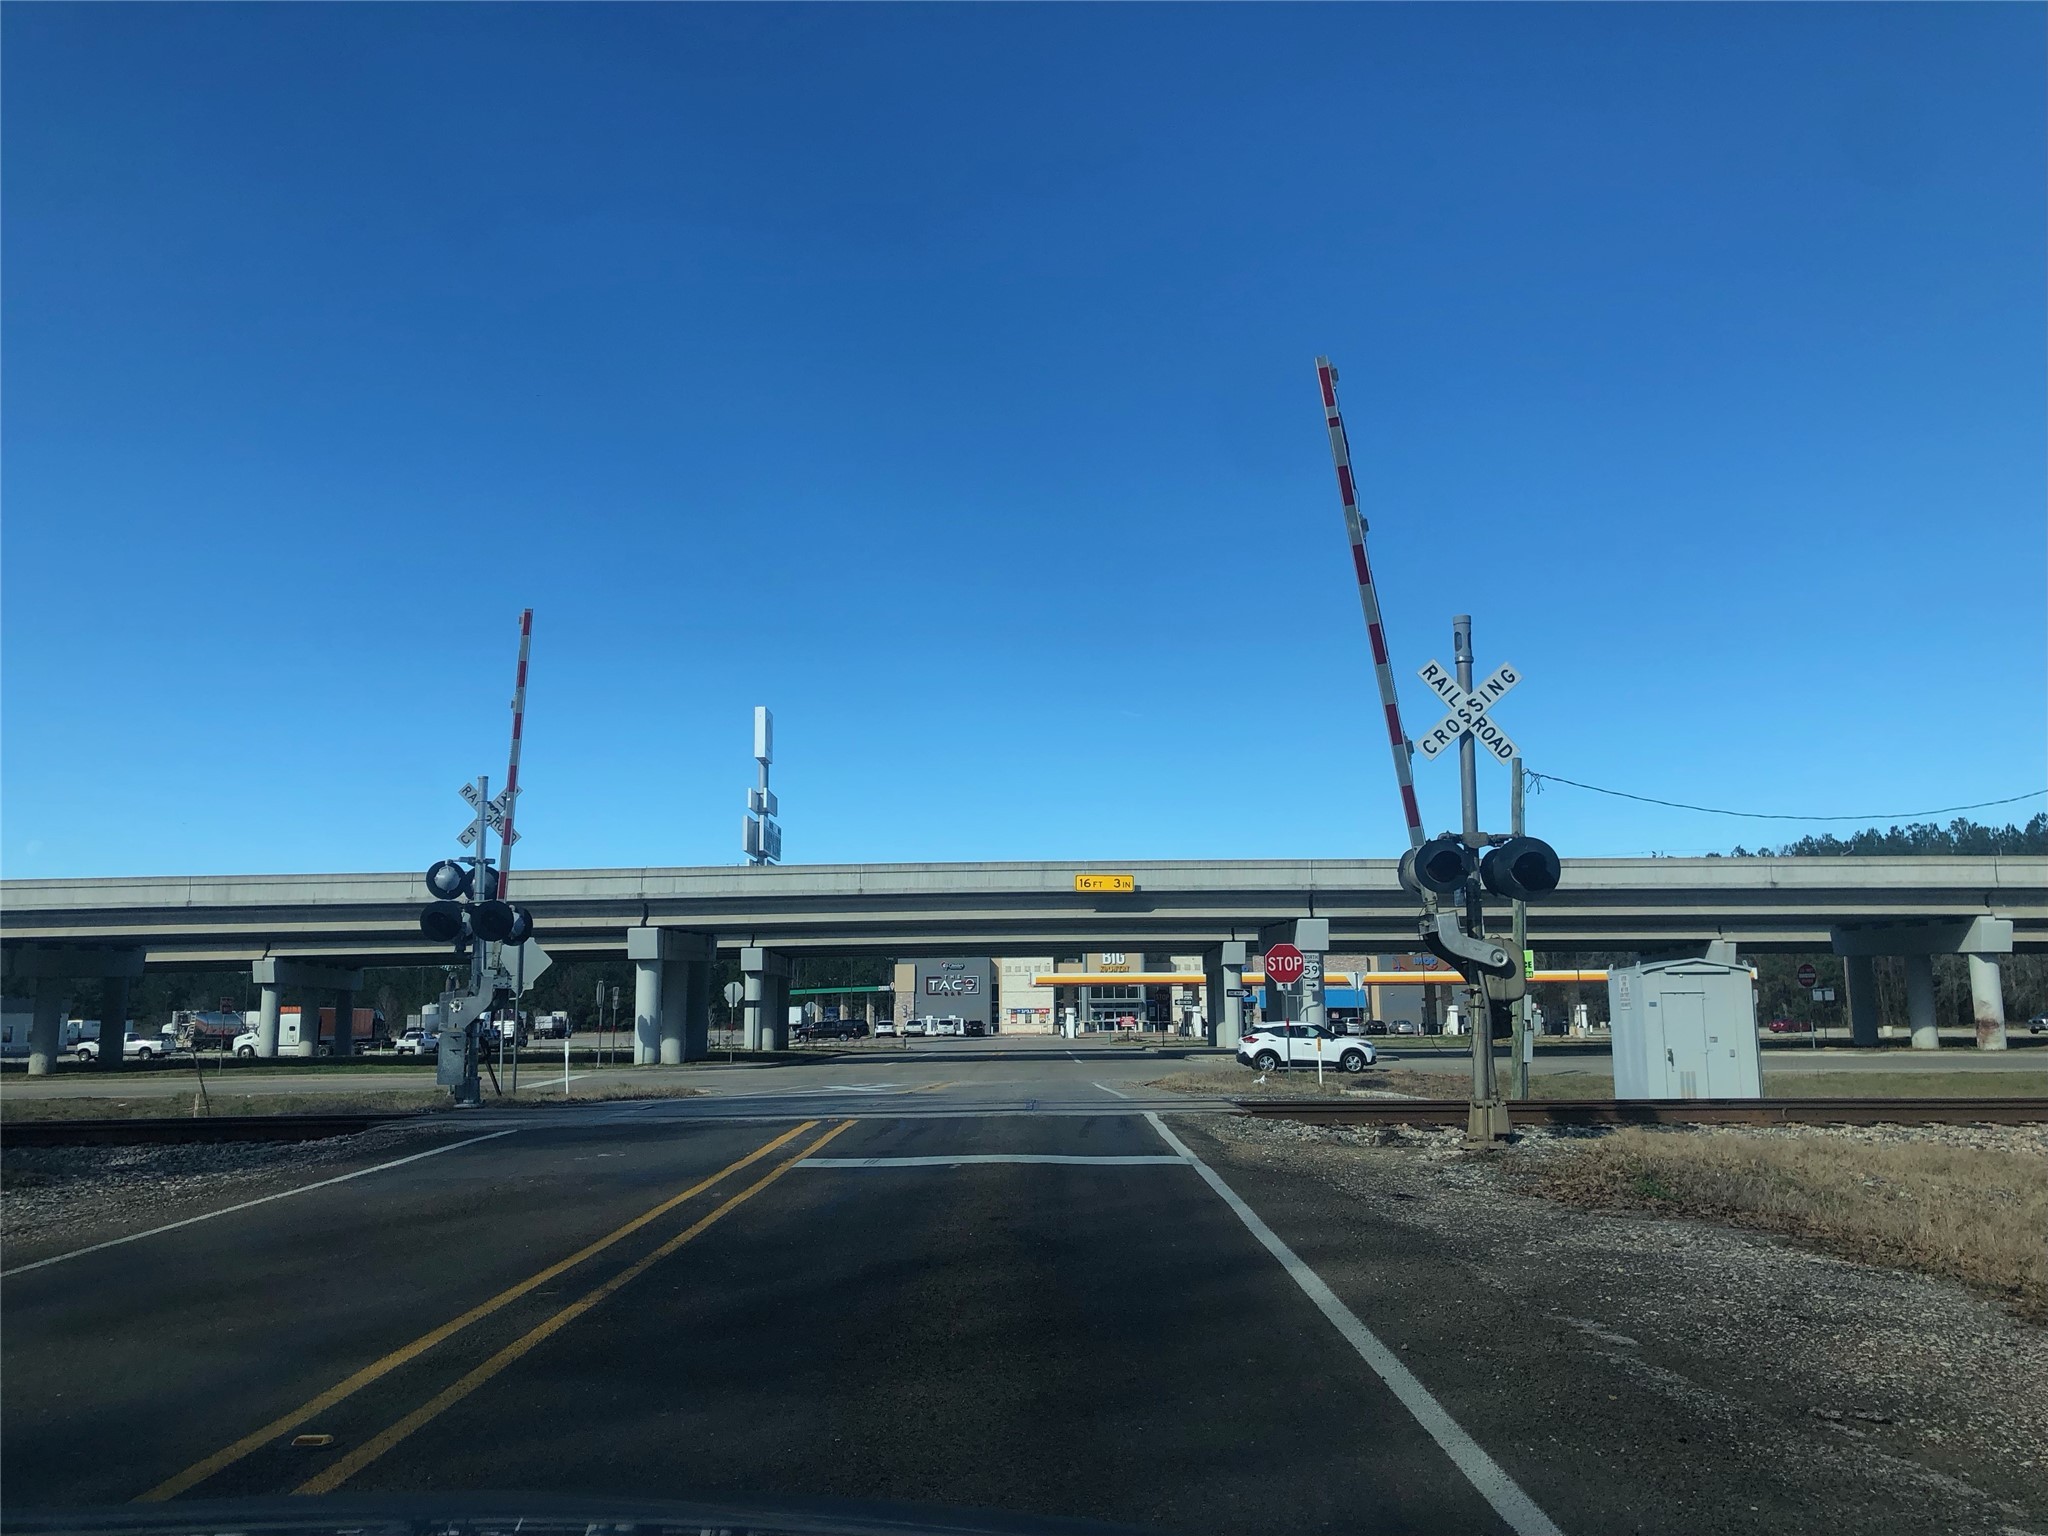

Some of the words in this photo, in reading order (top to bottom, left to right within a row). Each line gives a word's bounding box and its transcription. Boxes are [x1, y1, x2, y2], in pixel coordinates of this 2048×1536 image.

[1422, 664, 1461, 707] RAIL
[1471, 716, 1513, 758] ROAD
[1423, 669, 1515, 754] CROSSING
[1079, 878, 1091, 888] 16
[1113, 878, 1121, 888] 3
[1102, 953, 1126, 965] BIG
[1267, 956, 1302, 972] STOP
[1304, 965, 1318, 975] 59
